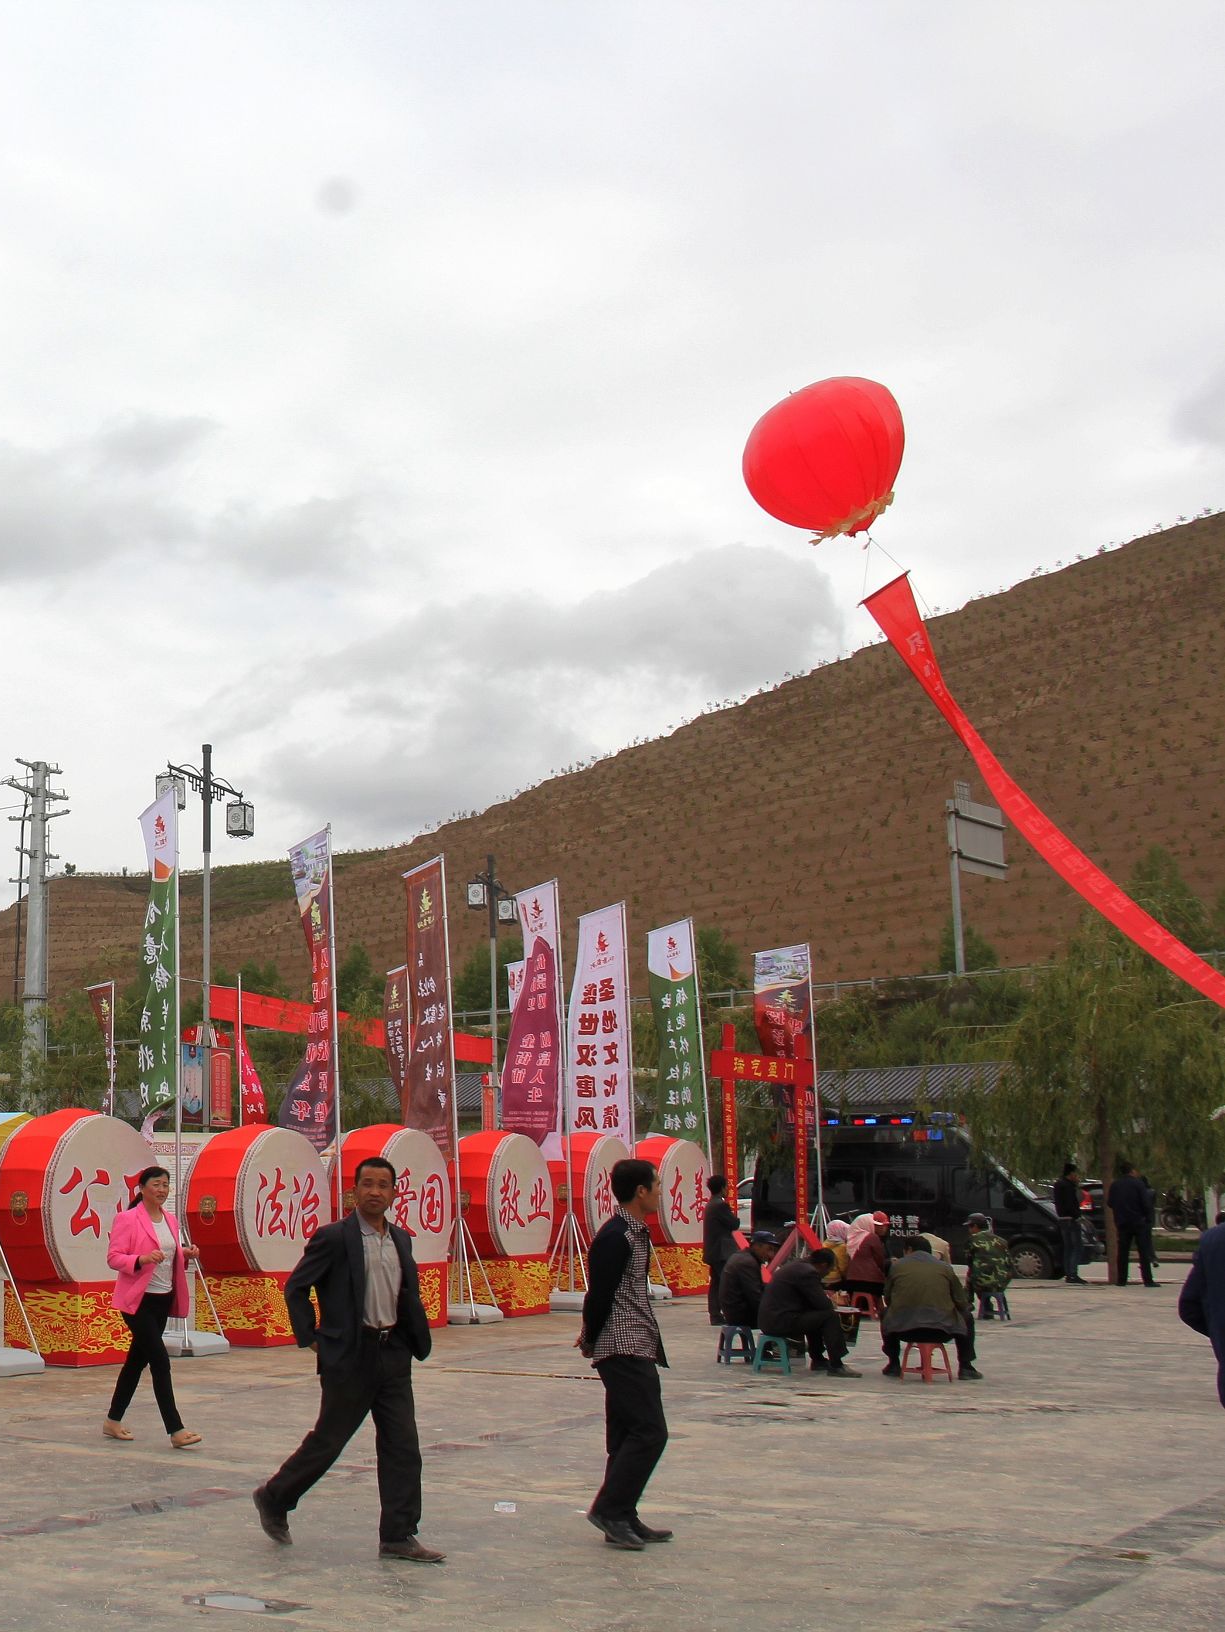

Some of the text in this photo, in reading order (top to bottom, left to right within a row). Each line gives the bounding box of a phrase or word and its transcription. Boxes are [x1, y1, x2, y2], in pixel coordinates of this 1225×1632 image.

[733, 1056, 794, 1080] 瑞气盈门
[254, 1166, 321, 1241] 法治
[389, 1166, 446, 1238] 爱国
[498, 1167, 551, 1231] 敬业
[670, 1166, 708, 1226] 友善
[889, 1214, 920, 1229] 特警
[889, 1229, 920, 1238] POLICE
